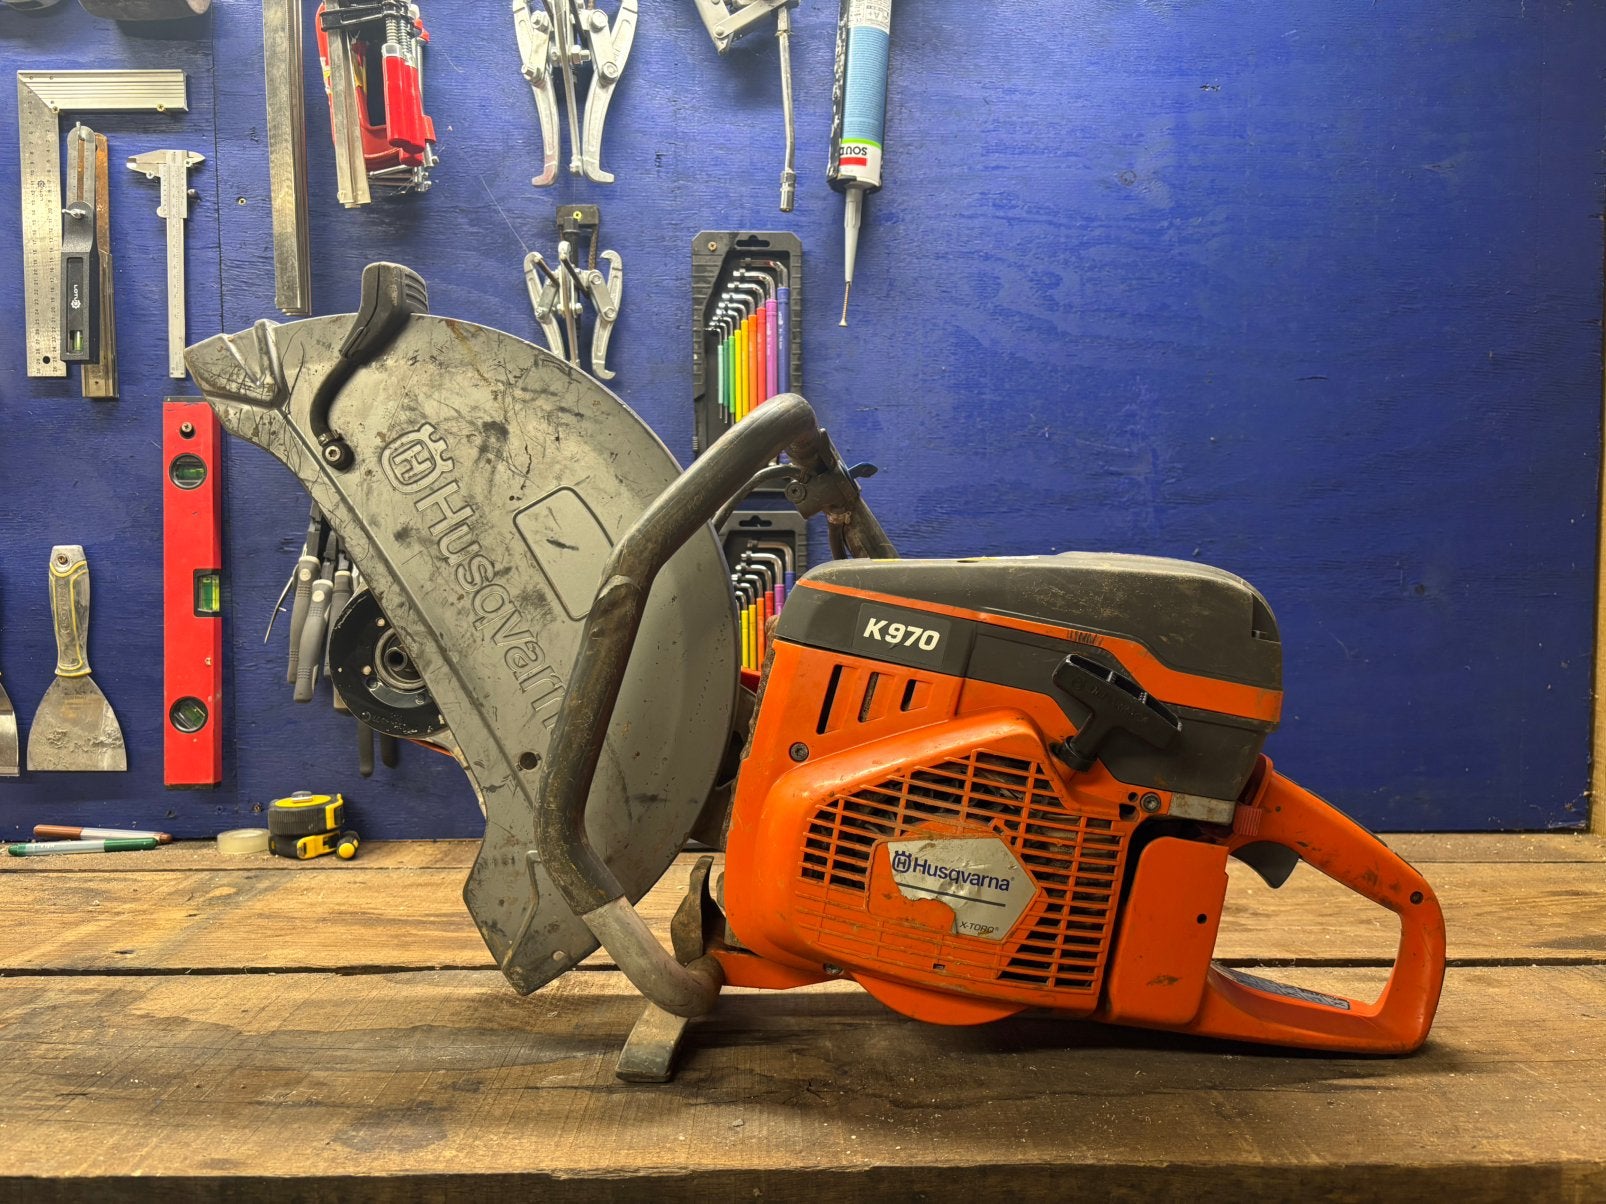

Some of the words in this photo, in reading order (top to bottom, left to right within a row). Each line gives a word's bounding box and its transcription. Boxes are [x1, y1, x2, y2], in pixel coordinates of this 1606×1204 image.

[413, 479, 567, 732] Husqvarn
[862, 617, 941, 651] K970
[912, 857, 1011, 892] Husqvarna
